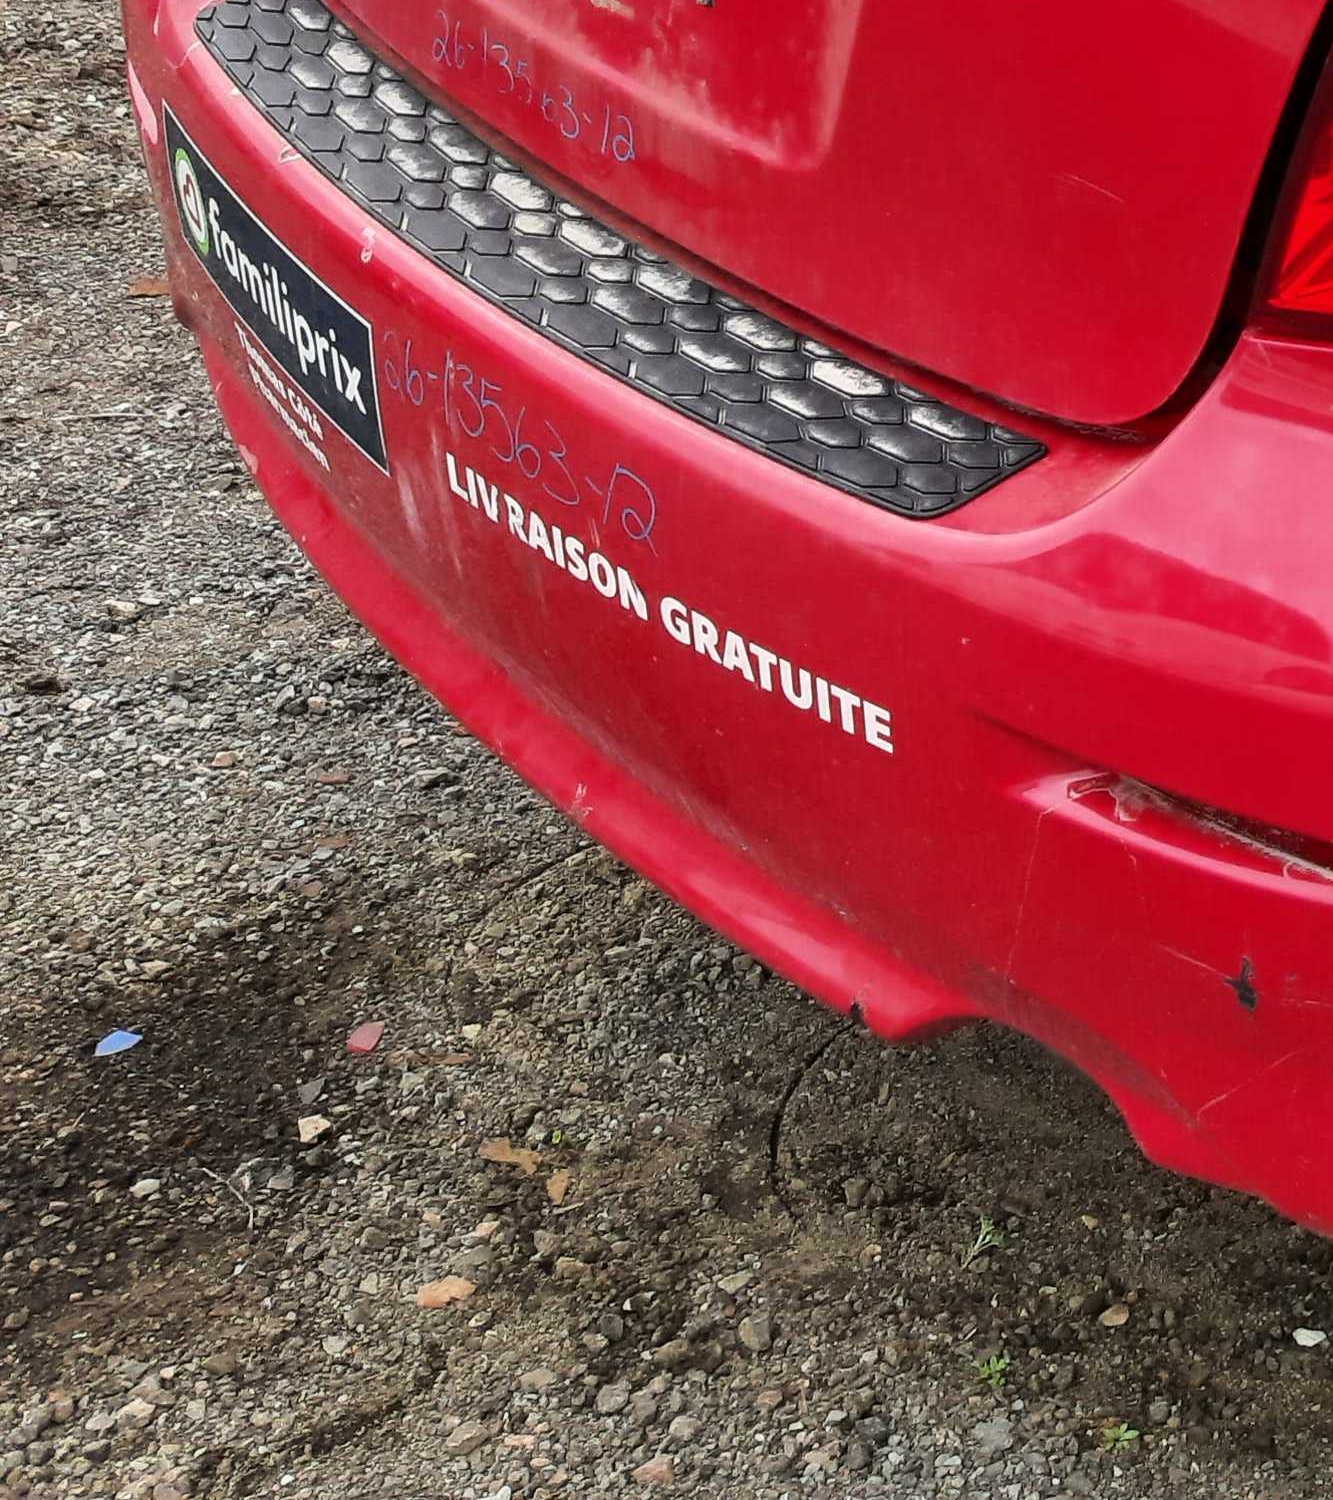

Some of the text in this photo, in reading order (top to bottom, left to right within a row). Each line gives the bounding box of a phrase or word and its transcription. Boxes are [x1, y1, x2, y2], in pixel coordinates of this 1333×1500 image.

[208, 197, 368, 416] familiprix
[384, 331, 659, 558] 26-13563-12
[445, 451, 894, 754] LIVRAISON GRATUITE
